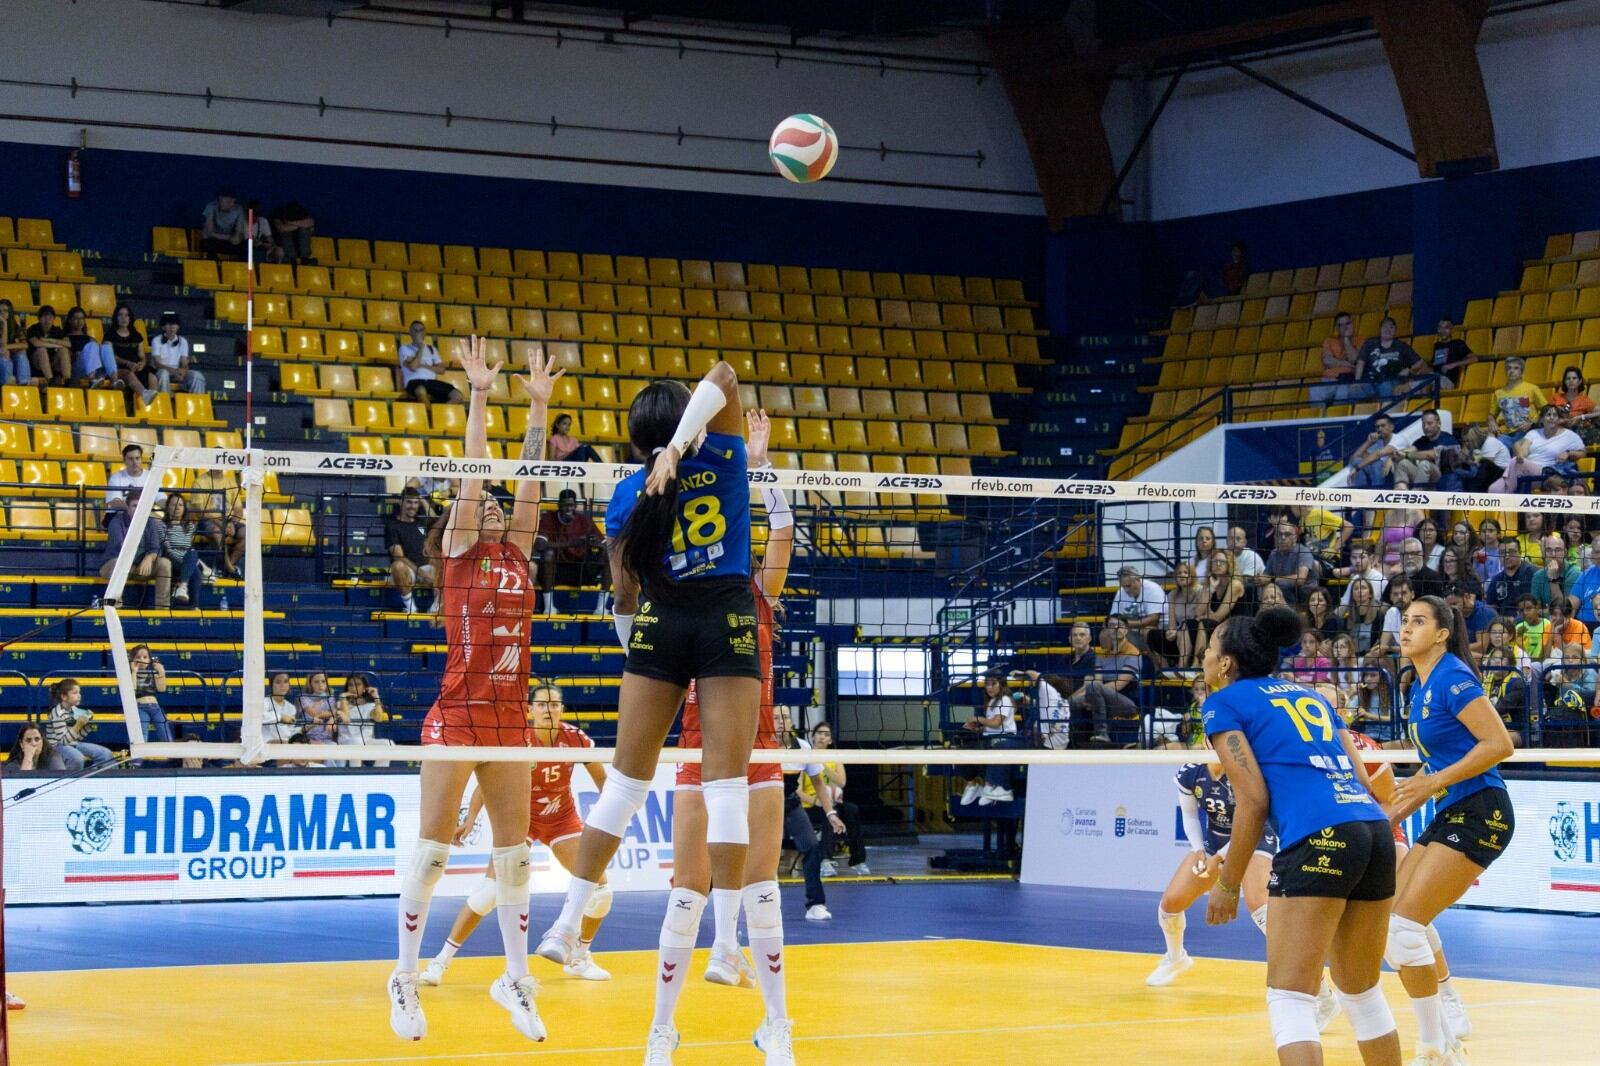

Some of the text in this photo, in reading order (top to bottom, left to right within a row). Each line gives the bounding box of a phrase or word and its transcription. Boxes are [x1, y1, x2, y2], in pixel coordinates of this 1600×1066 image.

[1029, 422, 1060, 433] FILA
[303, 429, 321, 440] 12
[419, 460, 492, 474] rfevb.com
[1022, 455, 1096, 466] FILA 12
[796, 474, 862, 487] rfevb.com
[971, 479, 1033, 492] rfevb.com
[1137, 486, 1196, 498] rfevb.com
[1295, 491, 1352, 502] rfevb.com
[1447, 494, 1500, 507] rfevb.com
[493, 567, 524, 595] 22
[1258, 684, 1309, 695] LAURA
[1269, 696, 1334, 742] 19
[541, 765, 562, 784] 15
[1205, 798, 1227, 815] 33
[123, 793, 396, 854] HIDRAMAR
[1127, 818, 1153, 827] Gobierno
[1135, 828, 1159, 836] Canarias
[1308, 838, 1347, 849] volkano
[187, 856, 286, 880] GROUP
[1301, 864, 1343, 876] GranCanaria
